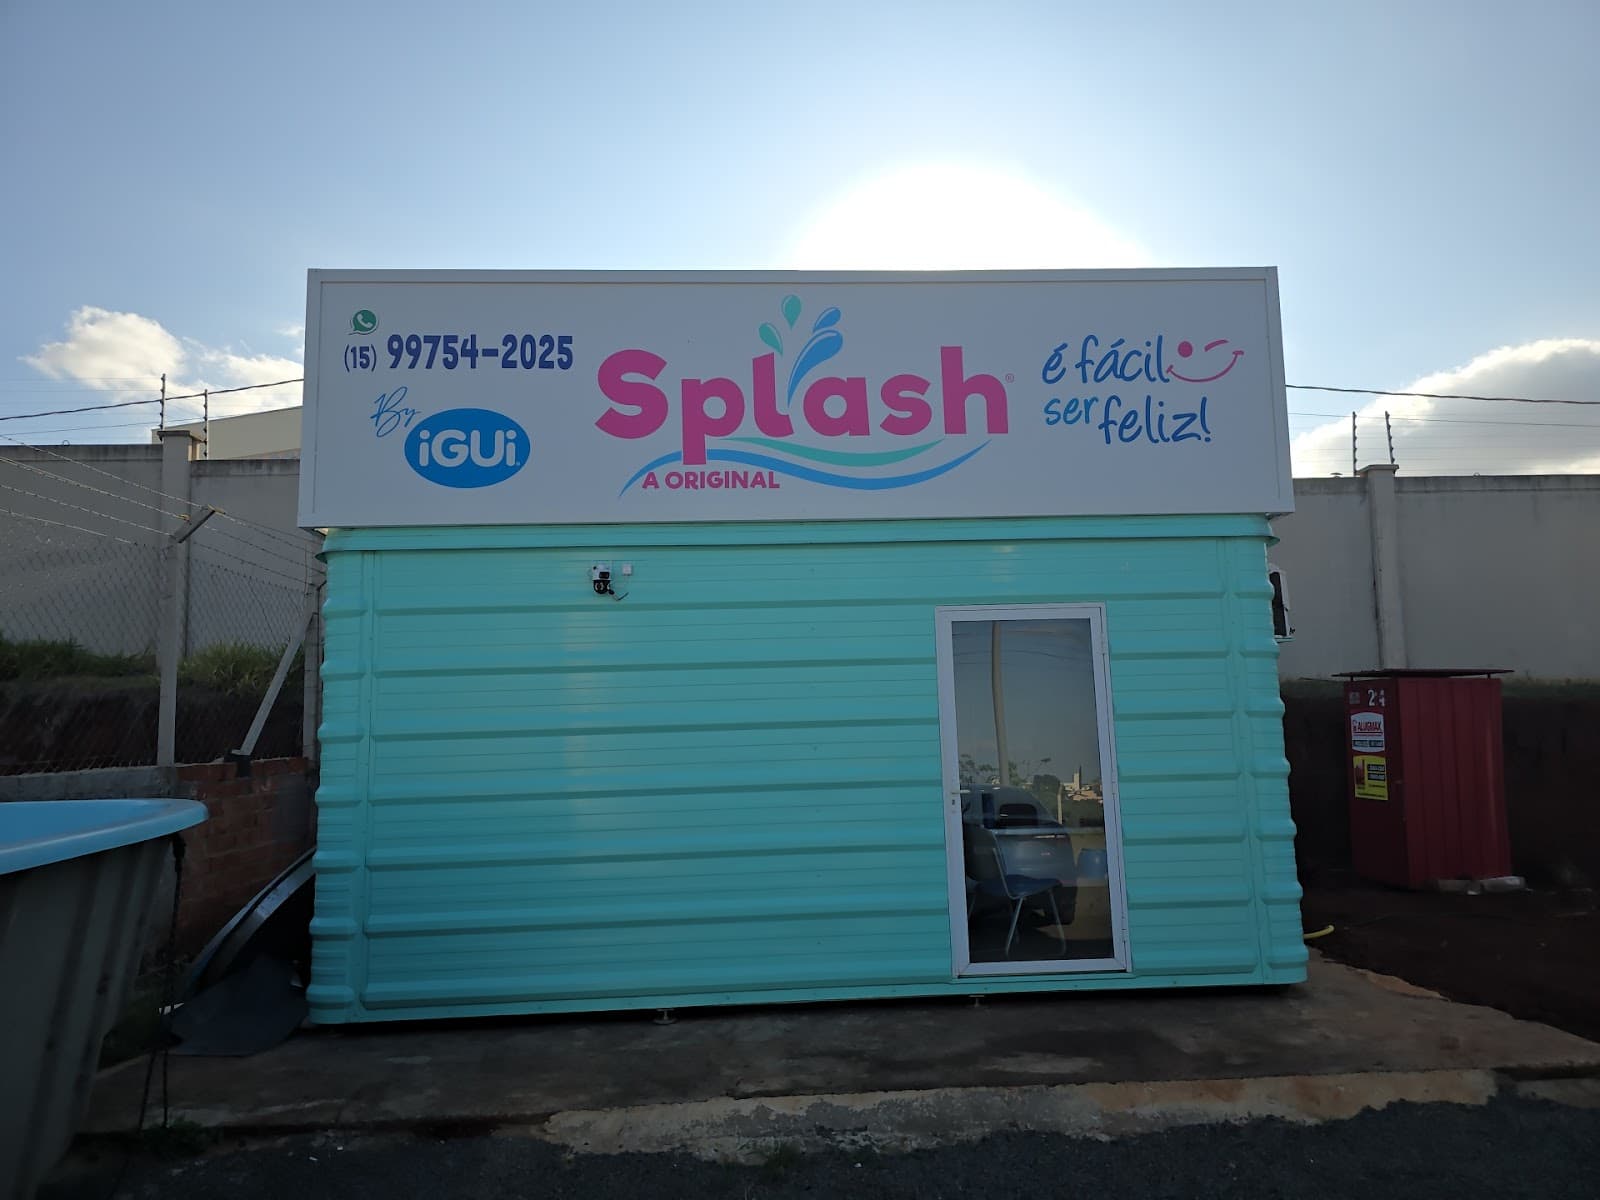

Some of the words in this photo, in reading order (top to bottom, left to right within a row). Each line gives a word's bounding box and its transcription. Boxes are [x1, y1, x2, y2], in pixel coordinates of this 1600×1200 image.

[344, 344, 377, 372] (15)
[387, 334, 573, 369] 99754-2025
[1042, 342, 1068, 384] é
[1075, 334, 1170, 383] fácil
[370, 386, 420, 438] By
[595, 346, 1008, 465] Splash
[1044, 396, 1099, 425] ser
[1098, 395, 1212, 444] feliz!
[419, 429, 517, 467] iGUi
[642, 471, 660, 489] A
[665, 471, 780, 489] ORIGINAL
